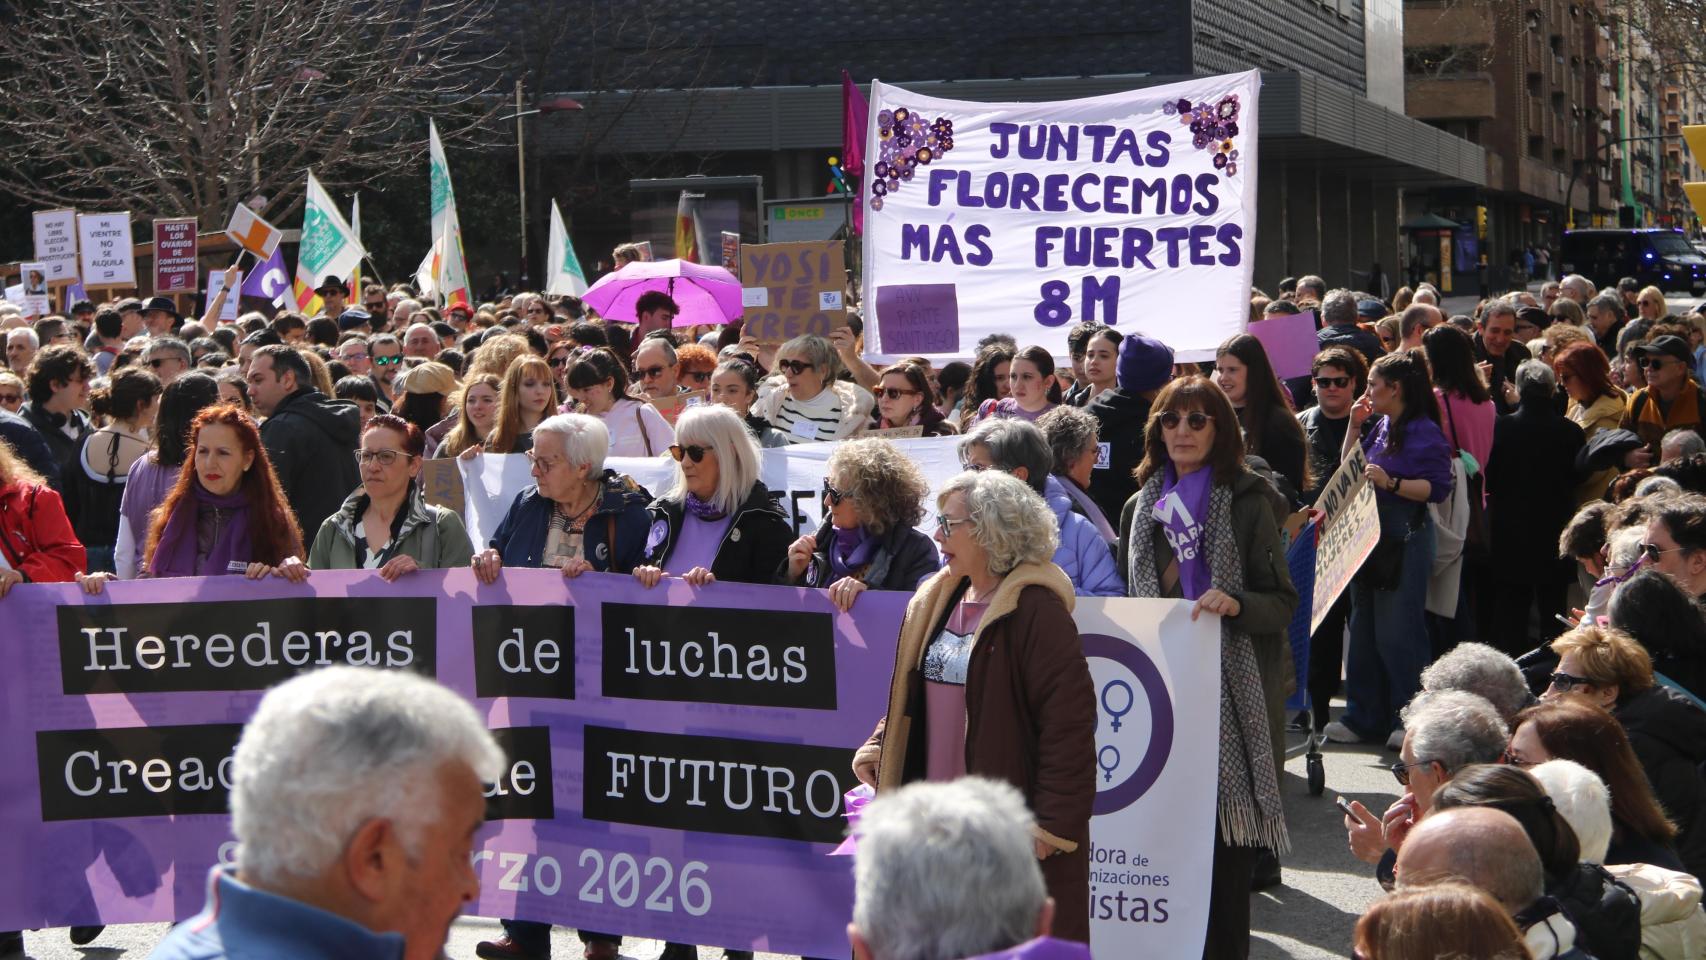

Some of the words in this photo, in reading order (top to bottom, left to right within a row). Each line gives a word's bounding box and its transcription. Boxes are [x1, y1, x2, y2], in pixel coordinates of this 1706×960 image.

[990, 122, 1171, 168] JUNTAS
[928, 170, 1219, 216] FLORECEMOS
[161, 240, 192, 248] OVARIOS
[901, 212, 993, 267] MÁS
[1035, 223, 1243, 270] FUERTES
[159, 257, 195, 265] CONTRATOS
[159, 265, 194, 273] PRECARIOS
[768, 286, 814, 310] TE
[1034, 275, 1121, 327] 8M
[746, 312, 831, 339] CREO
[887, 329, 954, 352] SANTIAGO
[1324, 489, 1339, 520] NO
[1336, 471, 1352, 500] VA
[1349, 450, 1365, 487] DE
[80, 622, 414, 671] Herederas
[497, 628, 561, 674] de
[625, 627, 808, 684] luchas
[606, 750, 841, 819] FUTURO
[1089, 868, 1170, 887] nizaciones
[1132, 853, 1149, 867] de
[578, 848, 712, 916] 2026
[1089, 885, 1169, 923] istas
